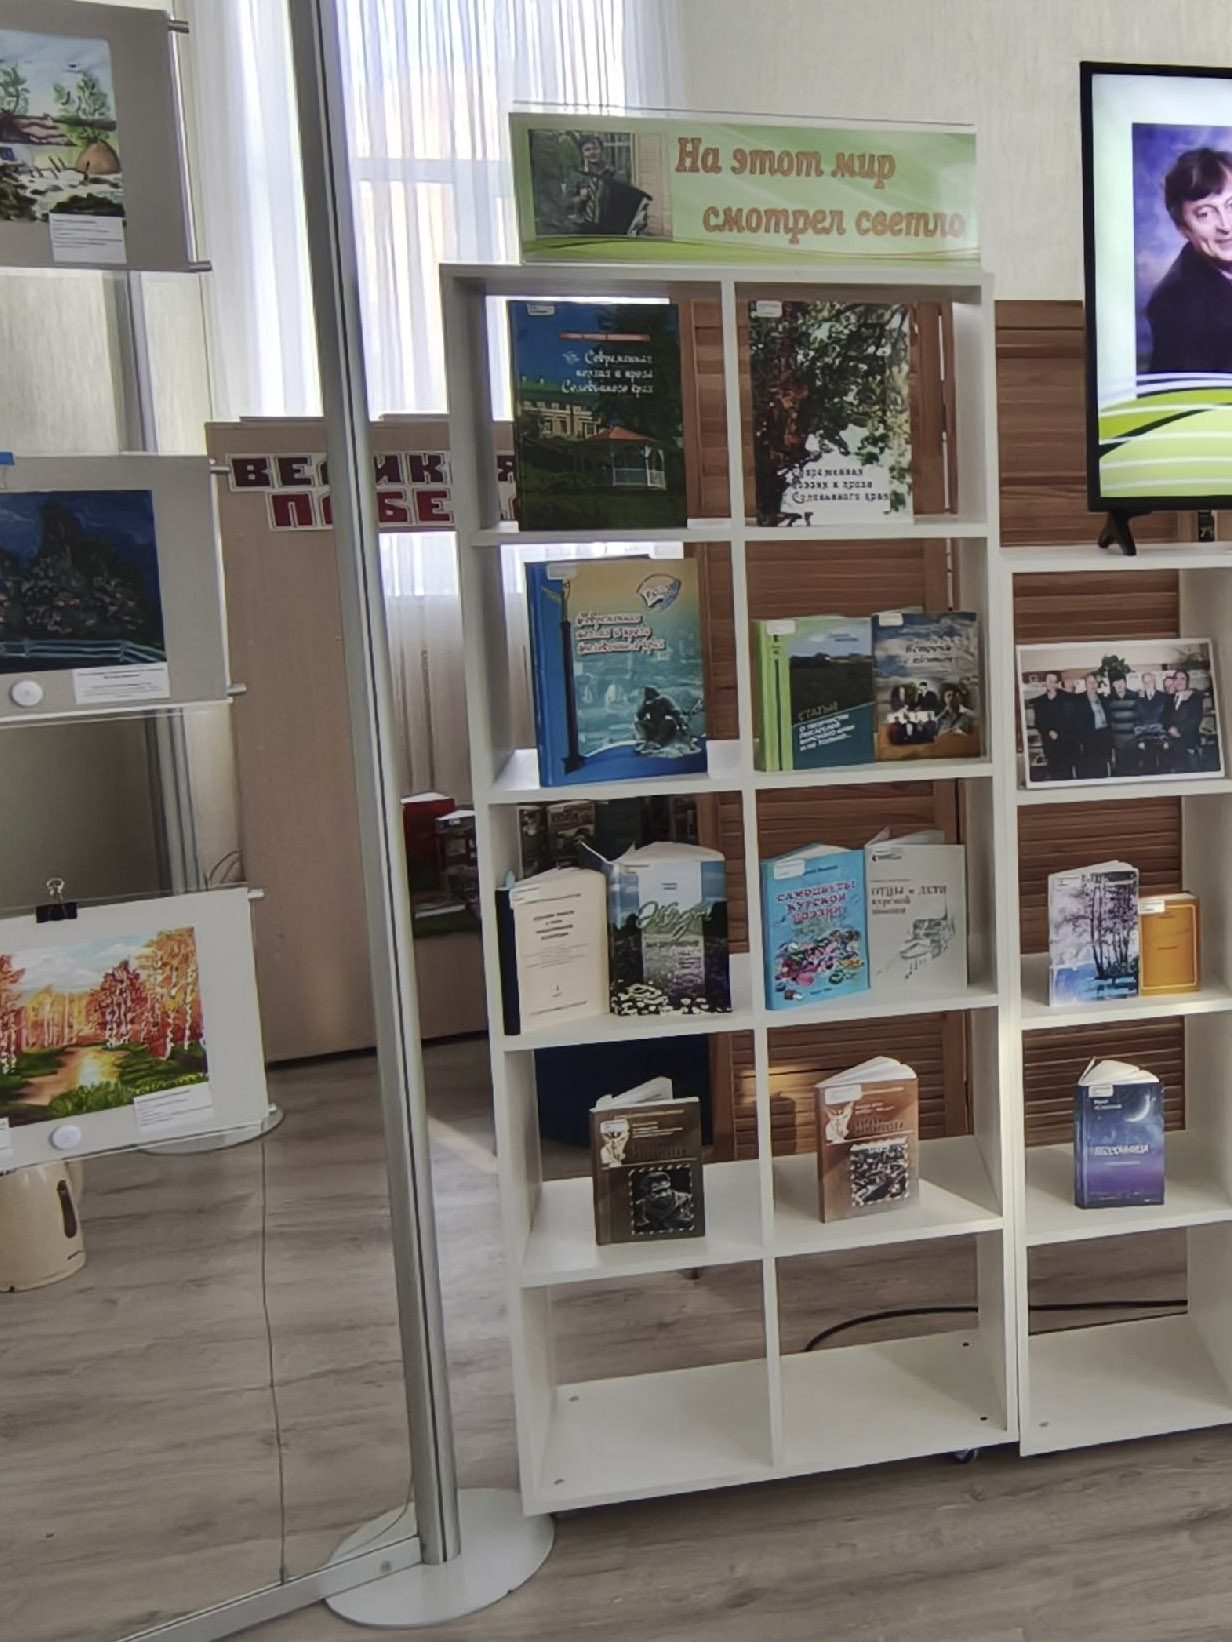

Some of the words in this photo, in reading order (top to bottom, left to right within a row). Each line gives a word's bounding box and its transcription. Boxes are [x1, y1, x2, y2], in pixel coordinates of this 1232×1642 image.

[675, 137, 723, 174] На
[730, 149, 824, 178] этот
[830, 152, 897, 189] мир
[702, 206, 847, 244] смотрел
[855, 209, 967, 238] светло
[231, 455, 517, 488] ВЕИКЯ
